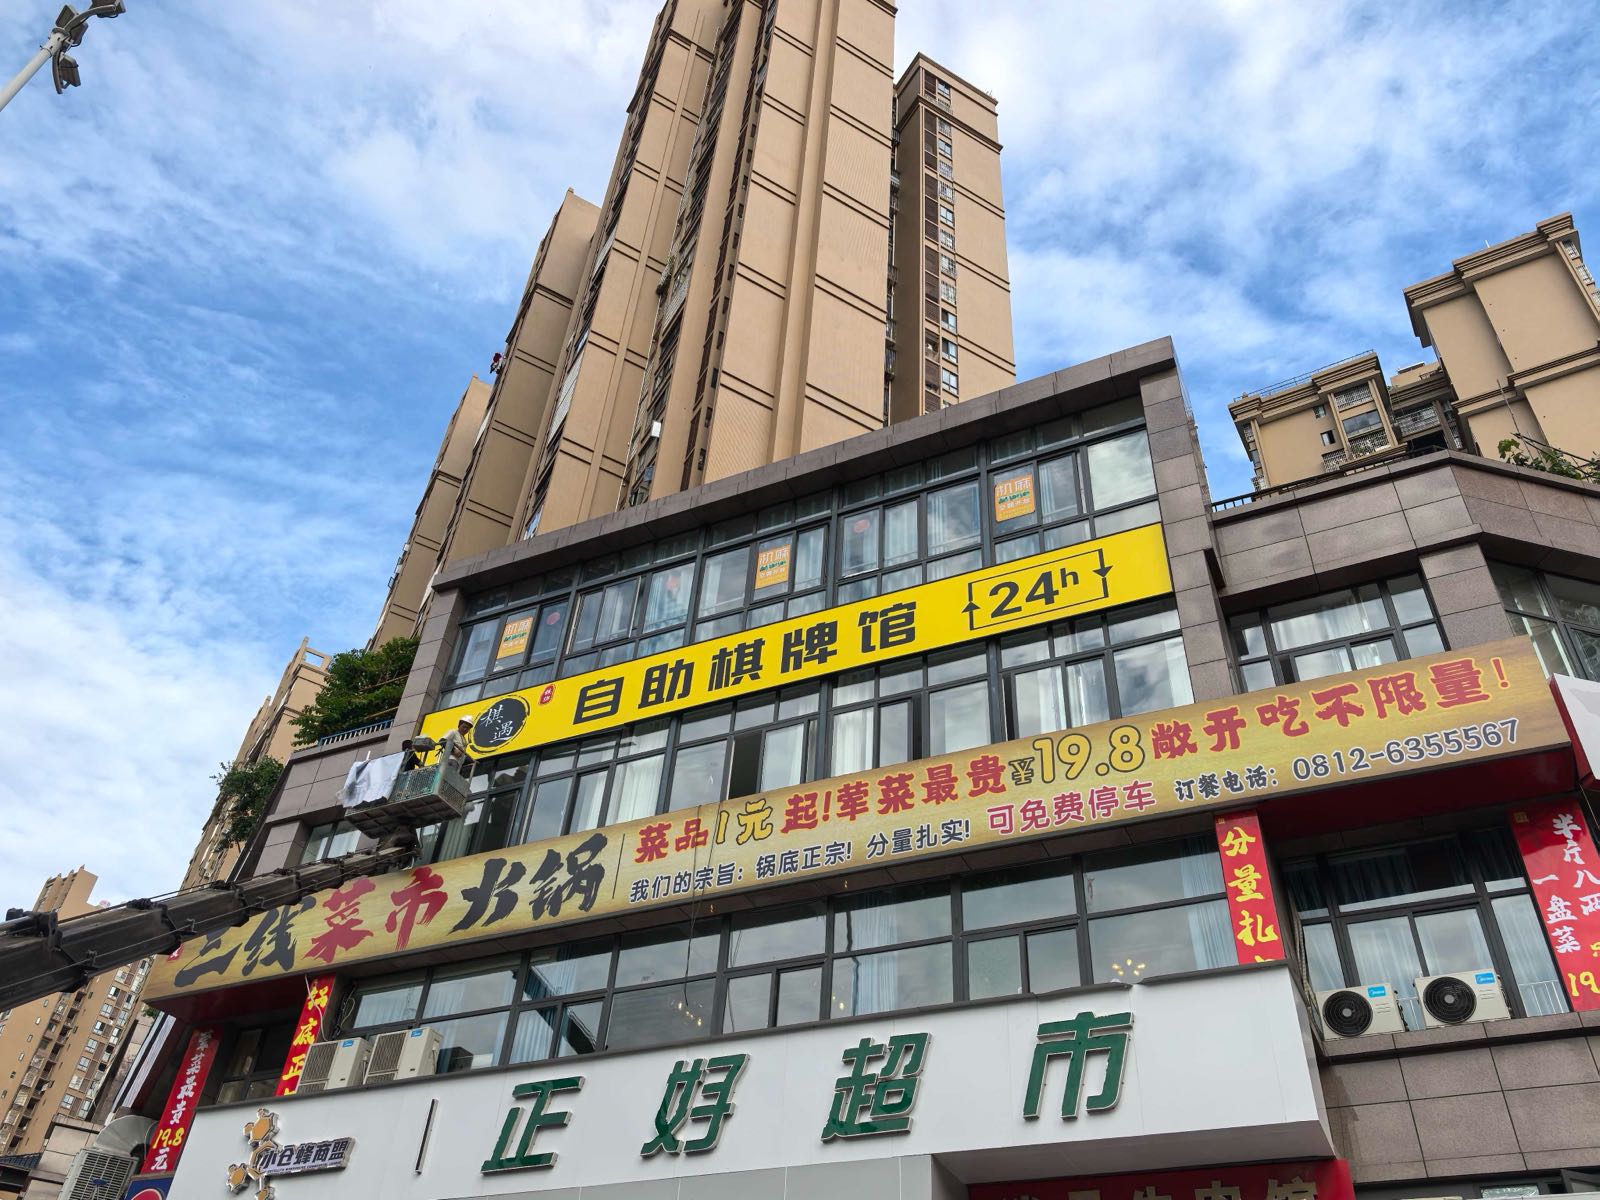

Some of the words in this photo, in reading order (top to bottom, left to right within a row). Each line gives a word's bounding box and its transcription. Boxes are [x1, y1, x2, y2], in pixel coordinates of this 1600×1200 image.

[989, 568, 1079, 619] 24h
[573, 601, 917, 725] 自助棋牌馆
[987, 780, 1156, 835] 可免费停车
[1221, 826, 1279, 963] 分量扎
[282, 986, 329, 1096] 锅底正
[481, 1011, 1135, 1175] 正好超市
